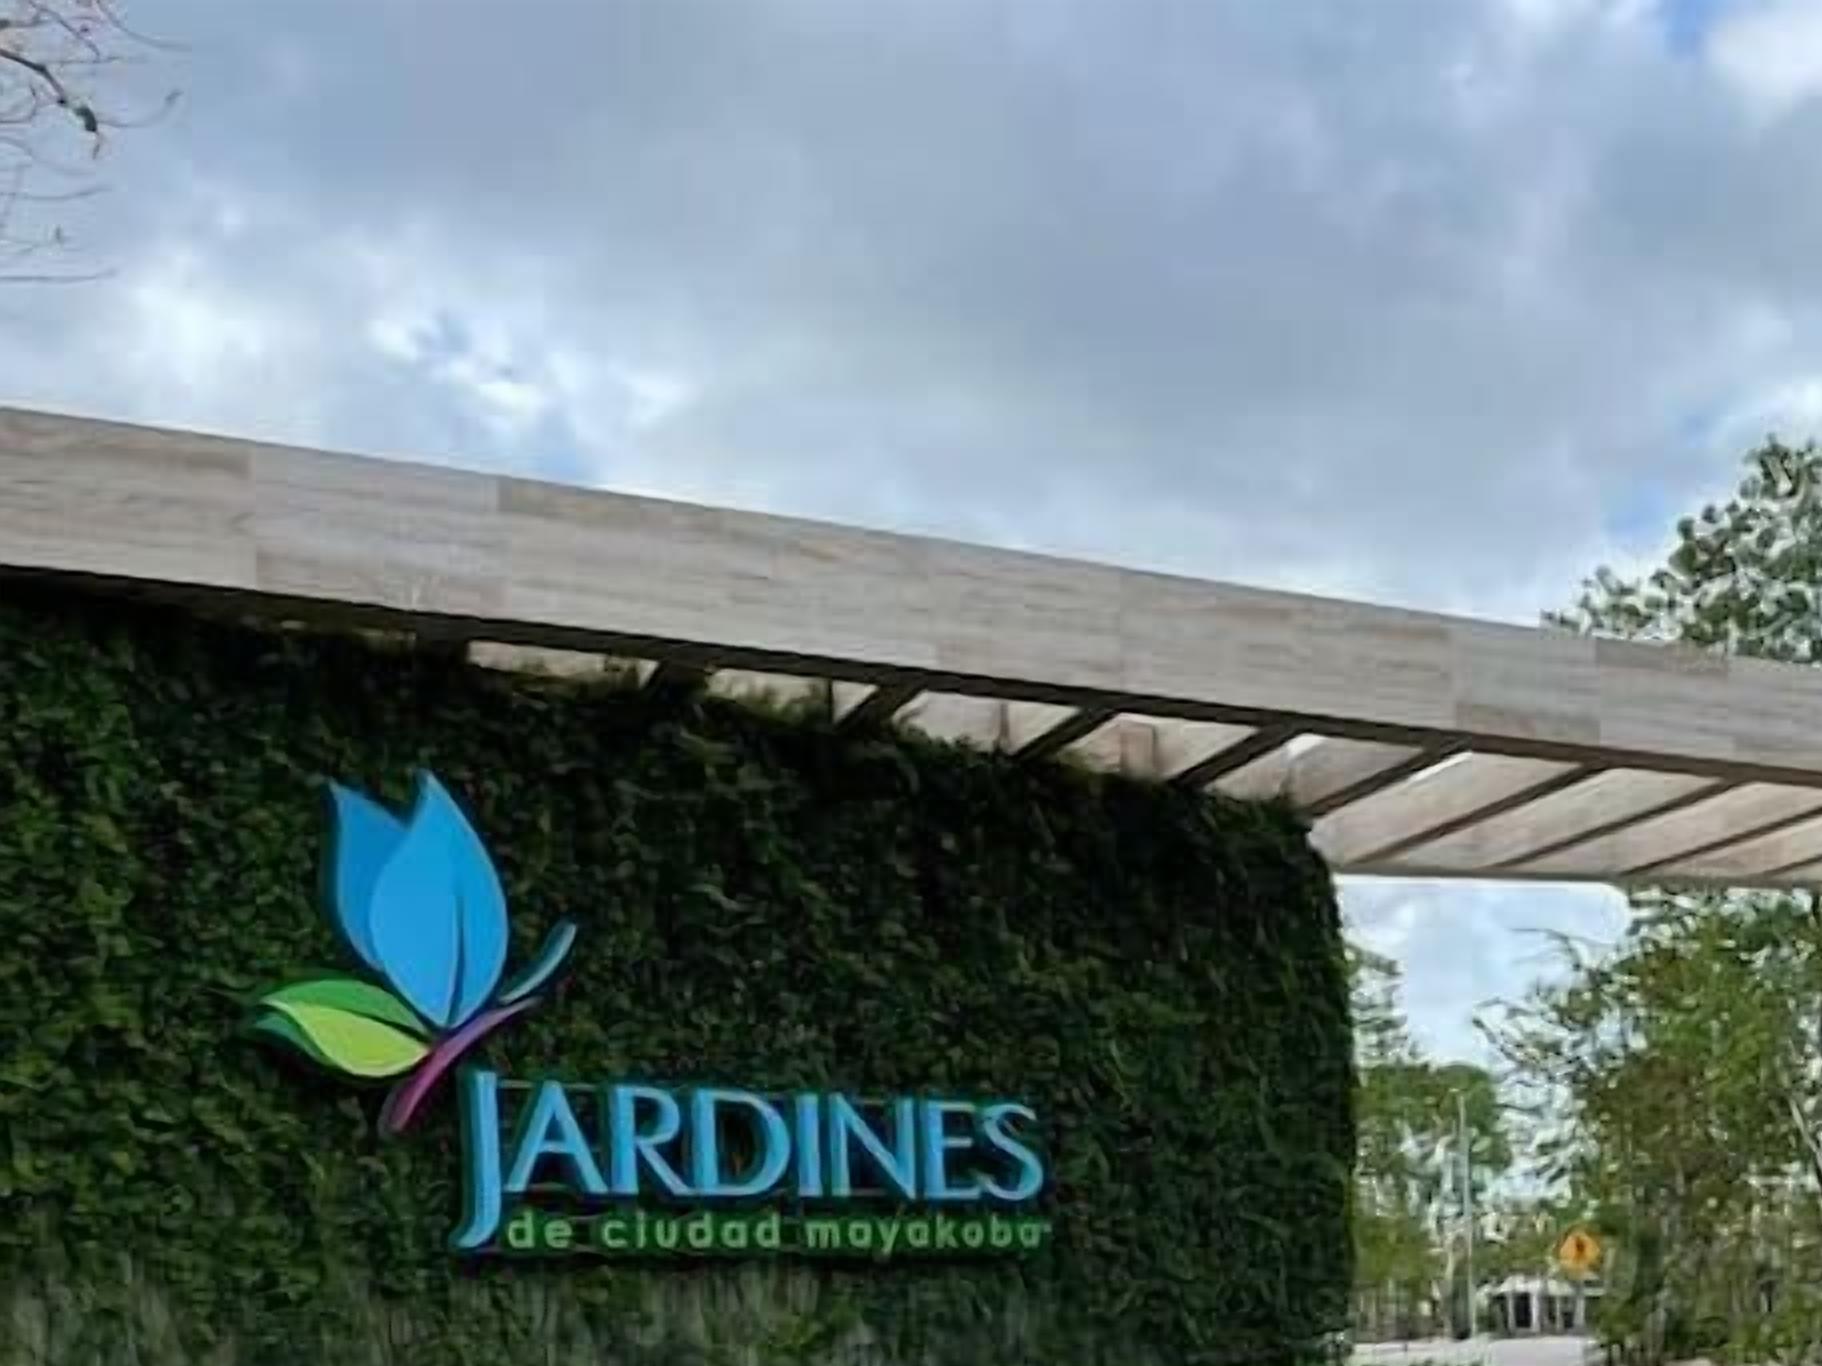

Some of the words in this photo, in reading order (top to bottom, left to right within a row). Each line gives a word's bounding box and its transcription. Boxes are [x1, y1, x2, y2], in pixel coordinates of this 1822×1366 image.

[456, 1069, 1044, 1248] JARDINES
[507, 1210, 570, 1249] de
[603, 1213, 782, 1249] ciudad
[805, 1214, 1042, 1256] mayakoba
